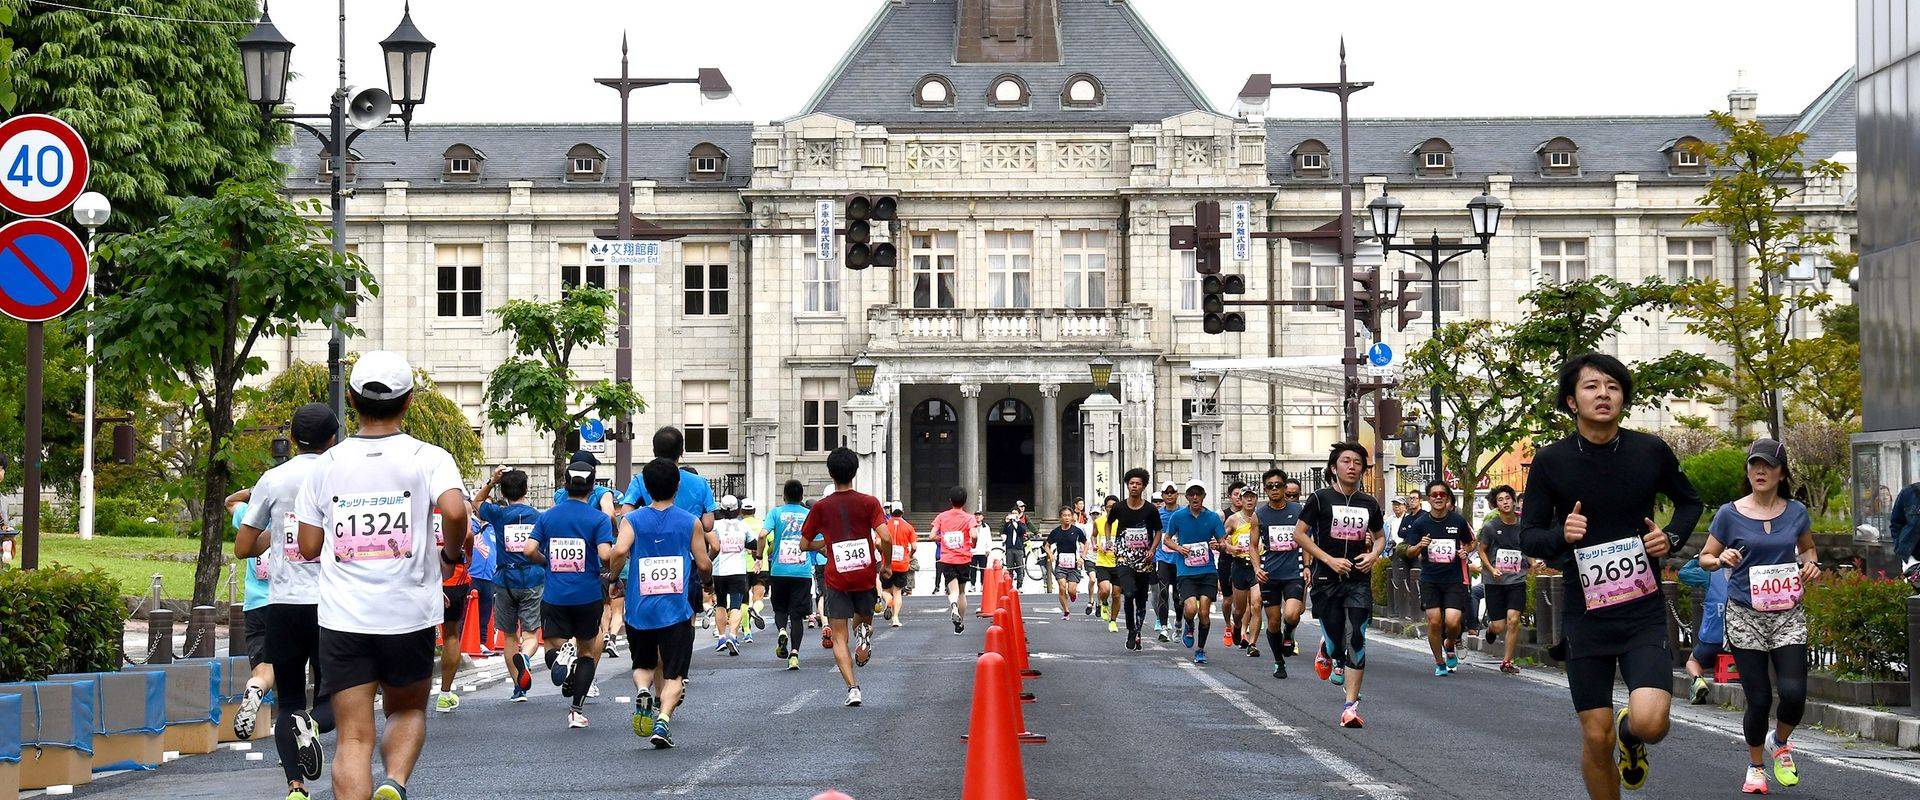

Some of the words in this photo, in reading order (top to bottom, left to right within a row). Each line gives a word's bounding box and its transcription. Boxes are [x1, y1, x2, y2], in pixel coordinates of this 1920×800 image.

[7, 144, 63, 187] 40
[821, 203, 829, 258] 歩車分離式信号
[1236, 204, 1245, 259] 歩車分離式信号
[610, 242, 658, 256] 文翔館前
[337, 496, 404, 508] ネッツトヨタ山形
[347, 512, 409, 537] 1324
[1333, 518, 1339, 527] B
[1343, 516, 1364, 529] 913
[1277, 533, 1294, 542] 633
[554, 548, 584, 560] 1093
[835, 554, 841, 563] B
[844, 547, 866, 561] 348
[1435, 545, 1452, 555] 452
[1578, 539, 1639, 561] ネッツトヨタ山形
[1503, 555, 1519, 565] 912
[641, 573, 646, 582] B
[651, 567, 677, 581] 693
[1581, 573, 1590, 588] D
[1589, 553, 1648, 586] 2695
[1752, 584, 1760, 595] B
[1760, 576, 1802, 595] 4043
